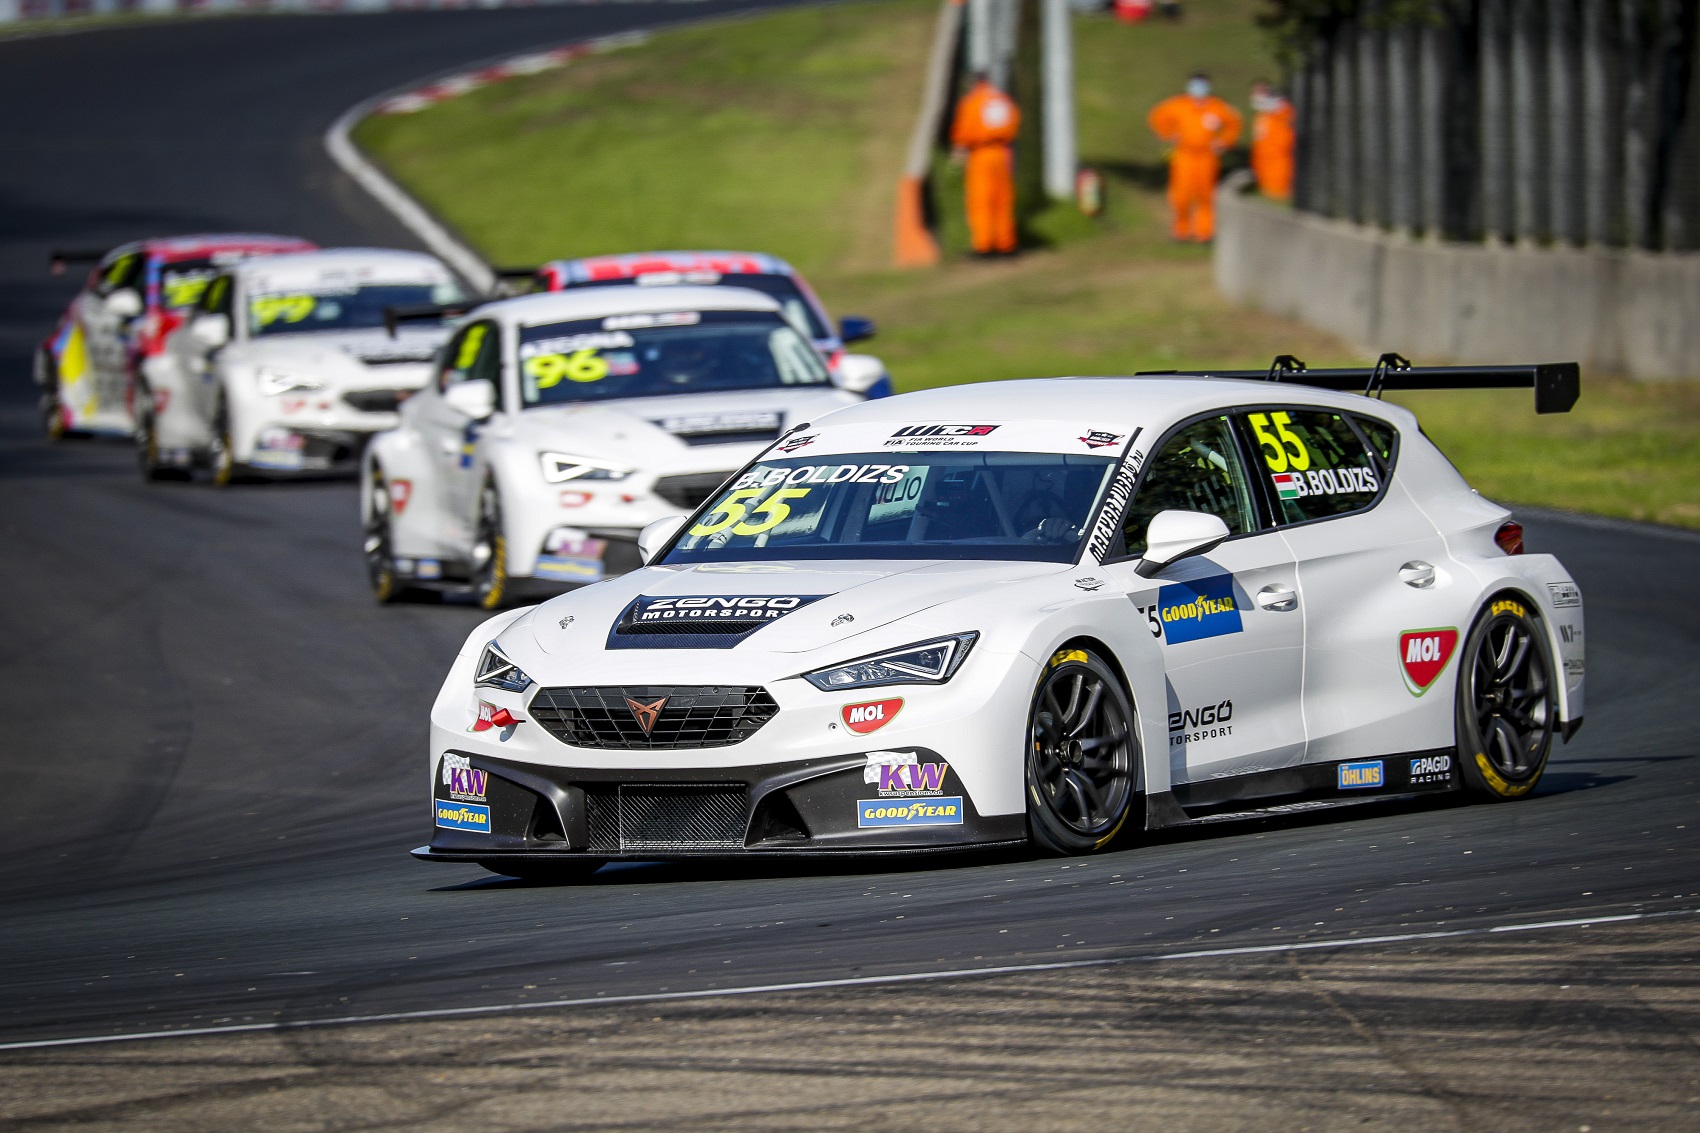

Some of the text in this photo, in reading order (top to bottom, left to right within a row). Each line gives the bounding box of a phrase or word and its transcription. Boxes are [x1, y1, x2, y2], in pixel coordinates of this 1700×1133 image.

[525, 348, 609, 388] 96
[1248, 411, 1310, 473] 55
[729, 464, 910, 491] B.BOLDIZS
[1292, 467, 1379, 496] B.BOLDIZS
[688, 488, 811, 536] 55
[1162, 595, 1235, 622] GOODYEAR
[1406, 637, 1441, 663] MOL
[849, 704, 885, 724] MOL
[879, 763, 948, 791] KW
[1421, 756, 1451, 773] PAGID
[450, 767, 488, 797] KW
[1411, 773, 1451, 784] RACING
[438, 808, 487, 824] GOODYEAR
[864, 803, 957, 820] GOODYEAR
